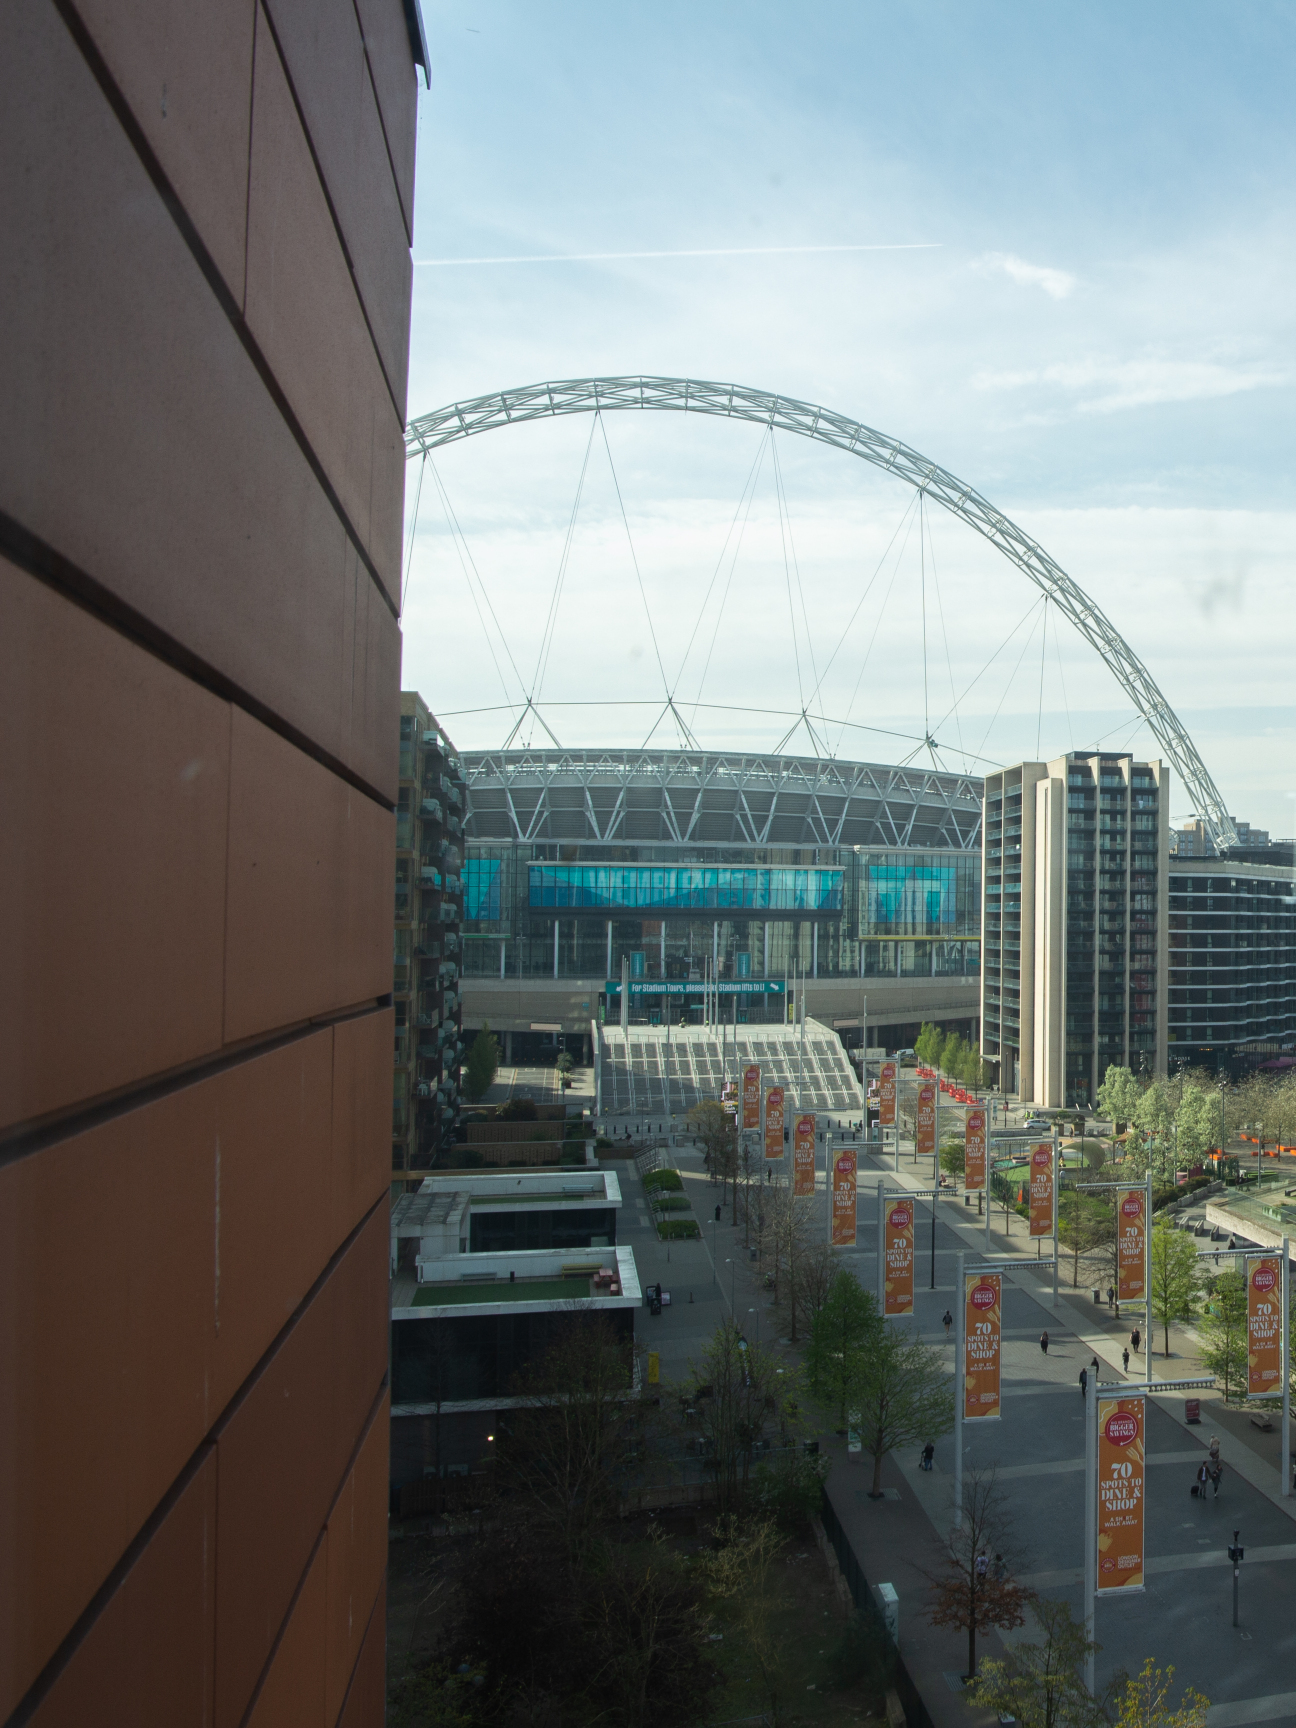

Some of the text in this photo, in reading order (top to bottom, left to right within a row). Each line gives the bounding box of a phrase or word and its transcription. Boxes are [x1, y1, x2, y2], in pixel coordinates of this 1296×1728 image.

[632, 984, 641, 992] For
[643, 984, 666, 992] Stadium
[667, 984, 685, 992] Tours,
[686, 984, 704, 992] please
[839, 1182, 850, 1190] 70
[1126, 1227, 1138, 1236] 70
[893, 1238, 906, 1248] 70
[1257, 1304, 1272, 1315] 70
[975, 1322, 991, 1335] 70
[1250, 1321, 1278, 1330] DINE &
[1253, 1330, 1275, 1338] SHOP
[968, 1342, 998, 1350] DINE &
[971, 1350, 995, 1359] SHOP
[1111, 1462, 1132, 1479] 70
[1101, 1478, 1142, 1489] SPOTS TO
[1102, 1487, 1141, 1500] DINE &
[1106, 1499, 1136, 1511] SHOP
